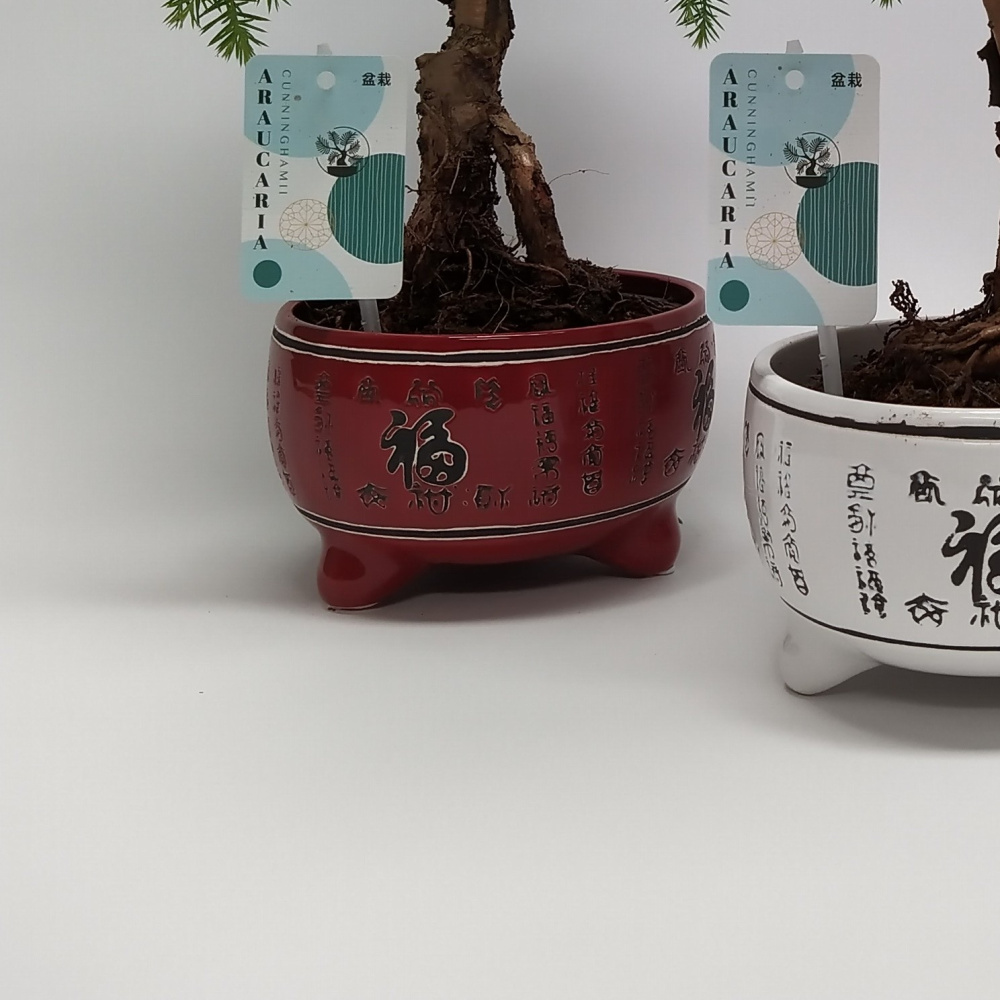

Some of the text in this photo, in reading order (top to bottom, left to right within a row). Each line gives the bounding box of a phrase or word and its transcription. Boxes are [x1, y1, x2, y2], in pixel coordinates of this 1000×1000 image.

[278, 69, 292, 195] CUNNINGHAMII
[361, 72, 392, 87] 盆栽
[831, 72, 863, 88] 盆栽
[253, 68, 273, 250] ARAUCARIA
[719, 68, 738, 269] ARAUCARIA
[380, 407, 468, 491] 福
